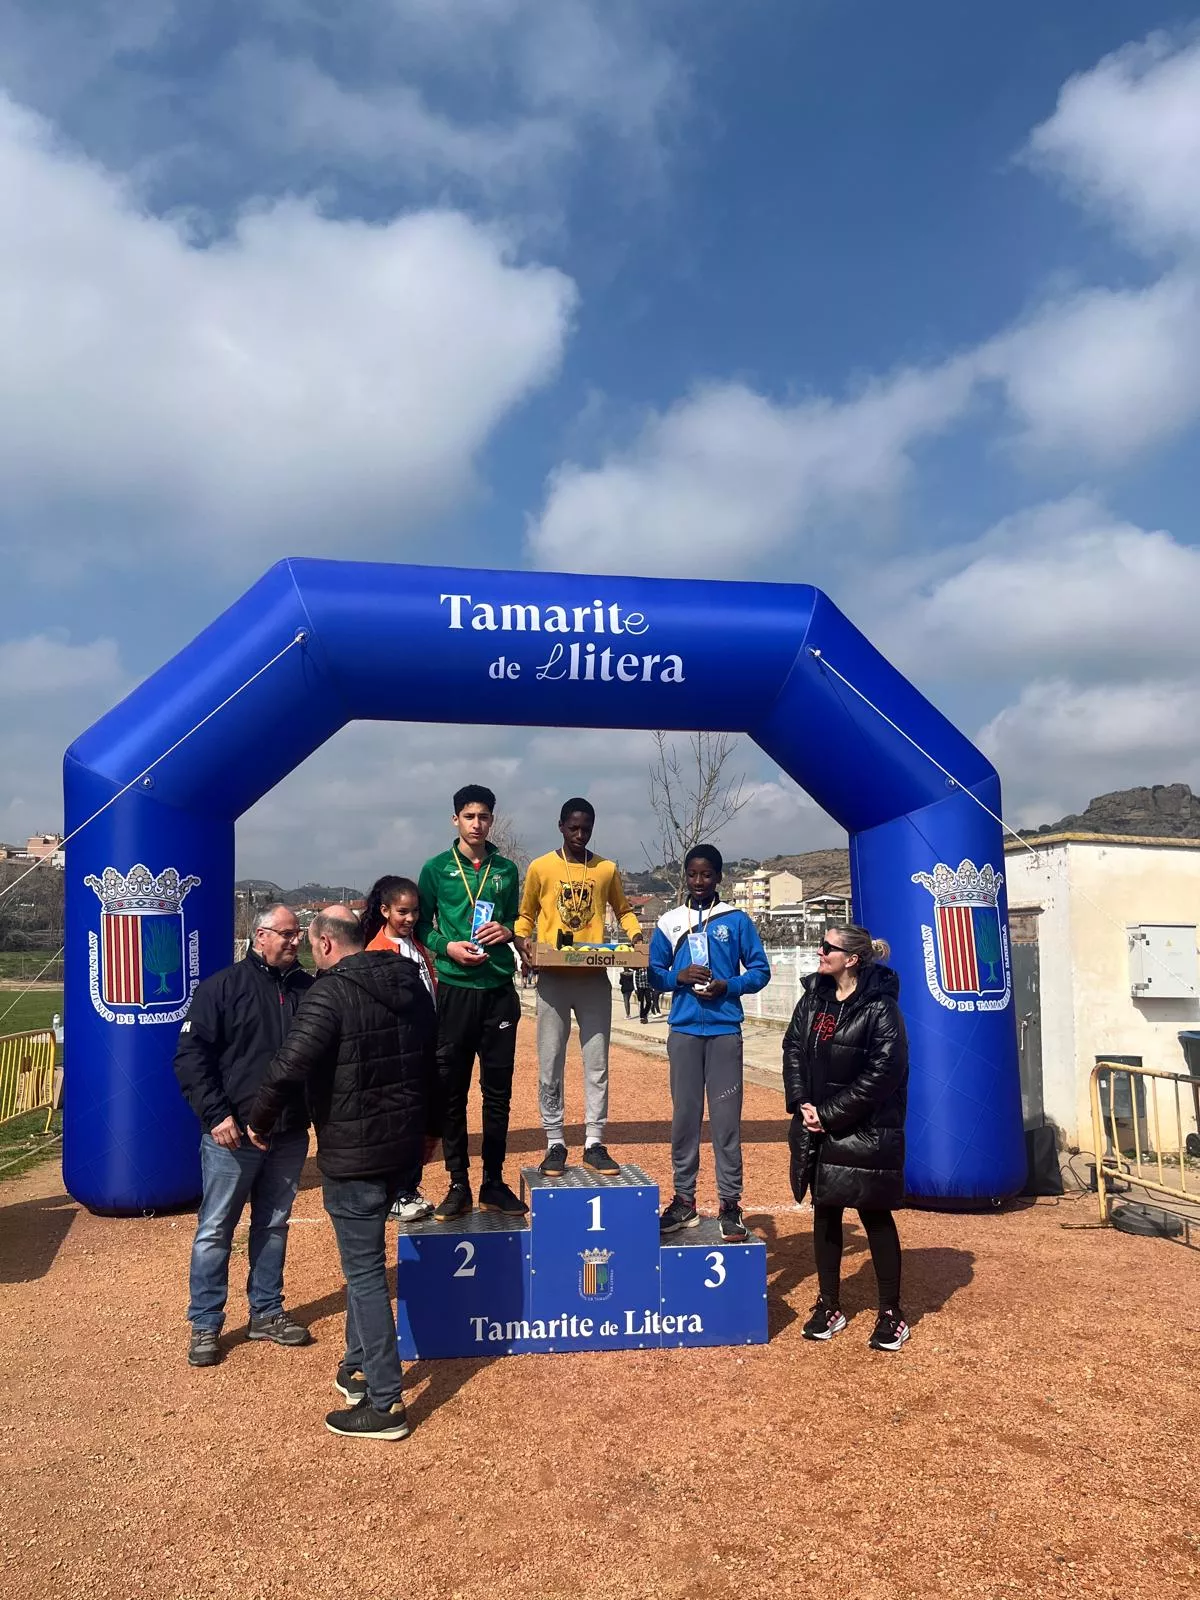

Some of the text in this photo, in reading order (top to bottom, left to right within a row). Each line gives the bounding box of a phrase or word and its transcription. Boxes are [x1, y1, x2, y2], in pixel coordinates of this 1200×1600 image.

[440, 594, 649, 635] Tamarite
[488, 656, 521, 680] de
[89, 930, 115, 1022] AYUNTAMIENTO
[117, 1012, 135, 1024] DE
[188, 930, 200, 977] LITERA
[586, 953, 616, 966] alsat
[921, 924, 956, 1011] AYUNTAMIENTO
[958, 1001, 974, 1011] DE
[586, 1195, 606, 1232] 1
[452, 1240, 477, 1278] 2
[703, 1251, 727, 1289] 3
[470, 1309, 704, 1342] Tamarite de Litera
